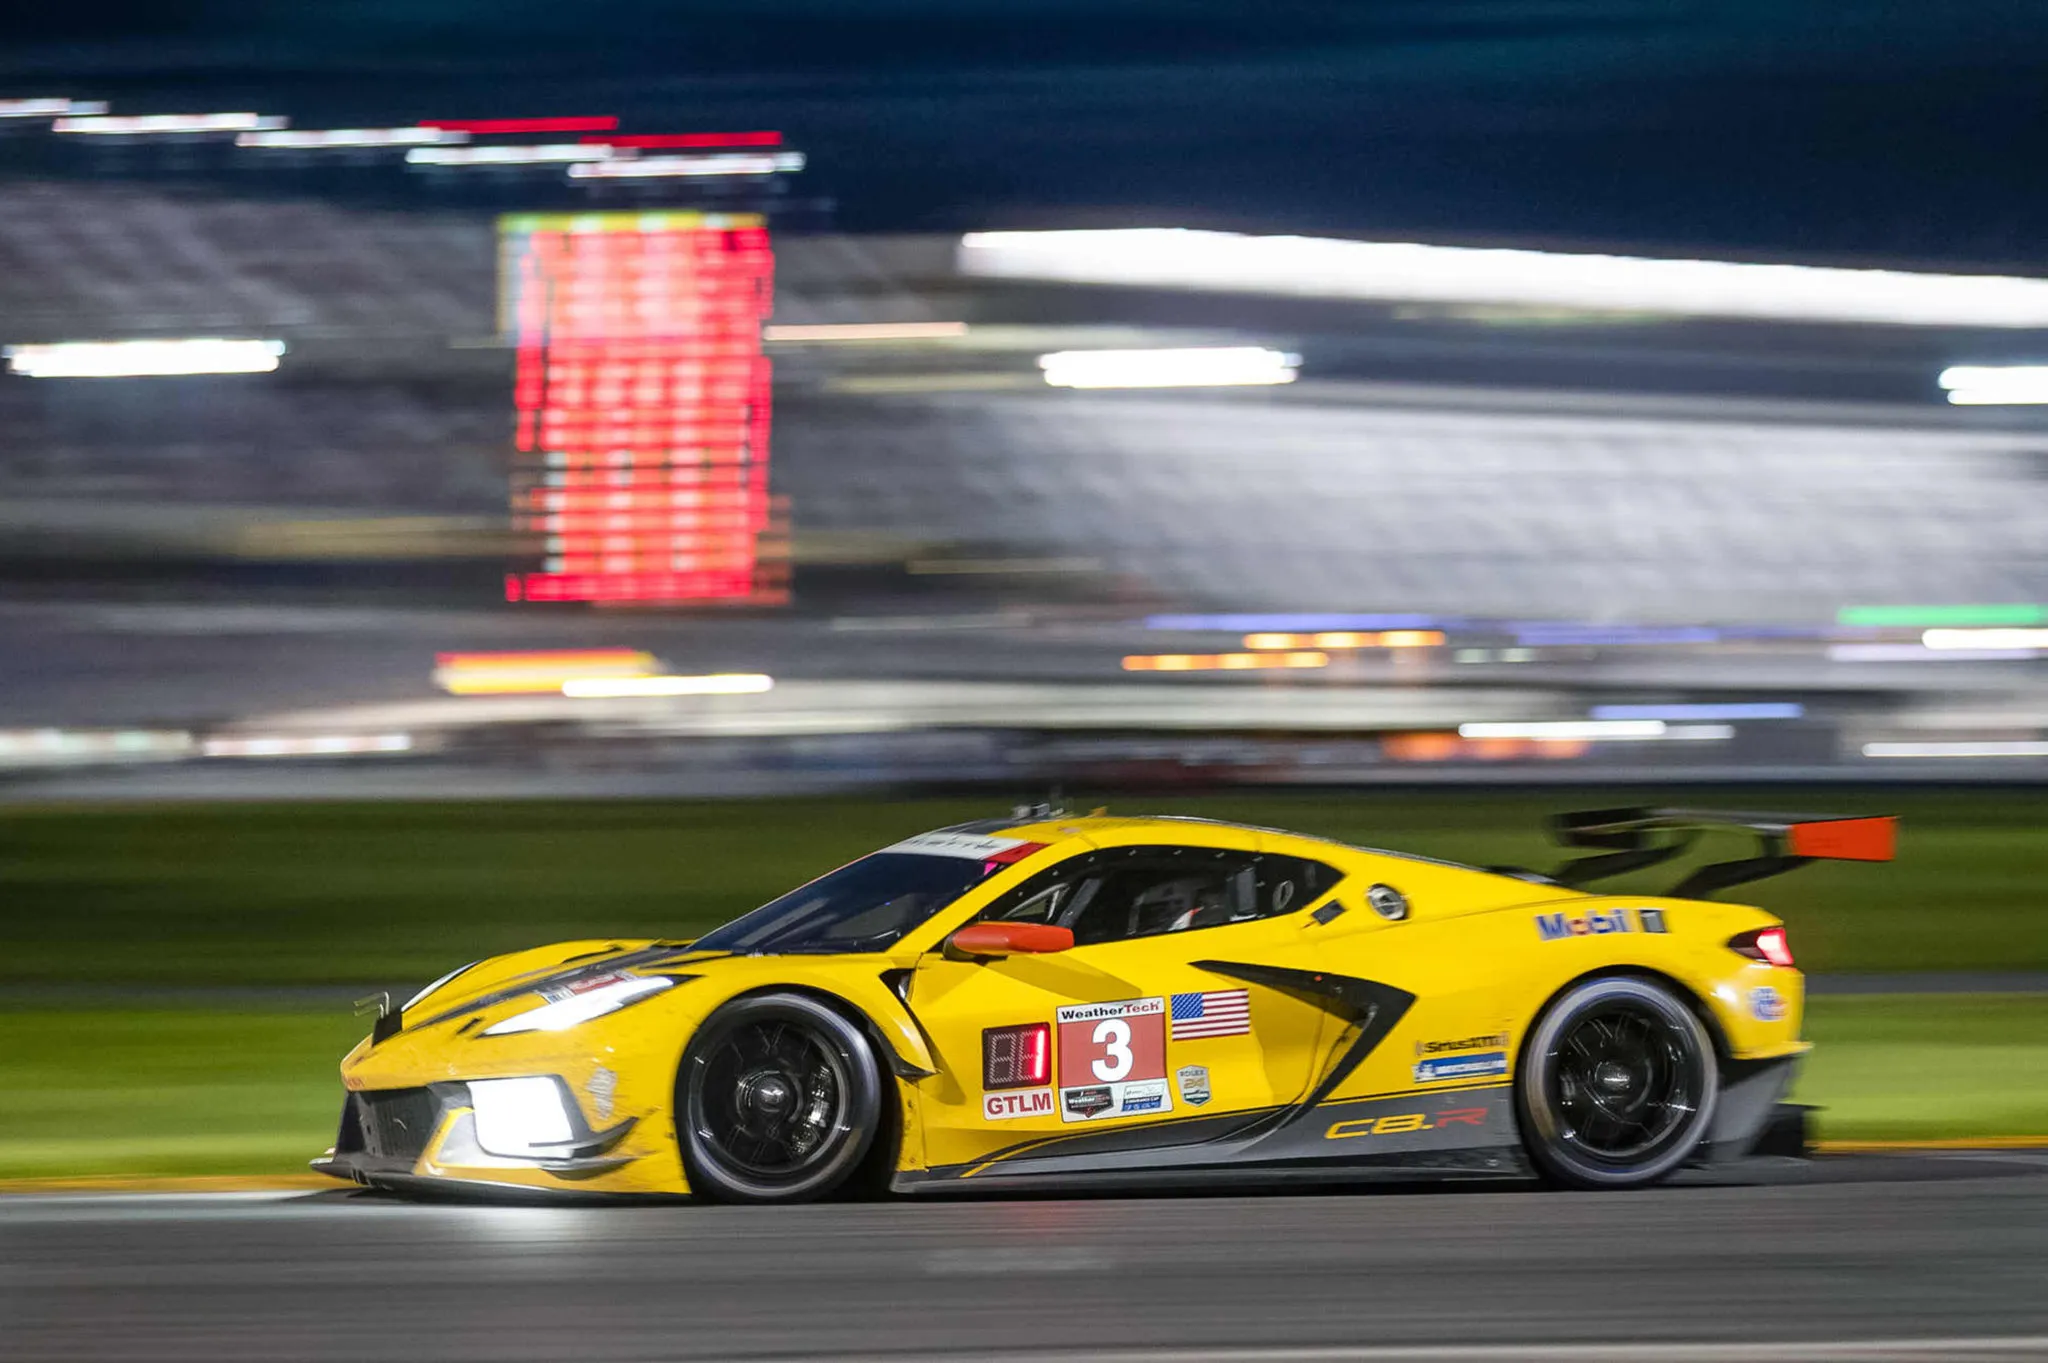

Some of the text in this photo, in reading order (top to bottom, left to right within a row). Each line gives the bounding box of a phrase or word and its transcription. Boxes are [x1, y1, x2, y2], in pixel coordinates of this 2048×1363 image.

[1535, 909, 1631, 942] Mobil
[1061, 1001, 1161, 1020] WeatherTech
[1091, 1018, 1134, 1083] 3
[986, 1092, 1052, 1116] GTLM
[1324, 1107, 1488, 1140] C8.R
